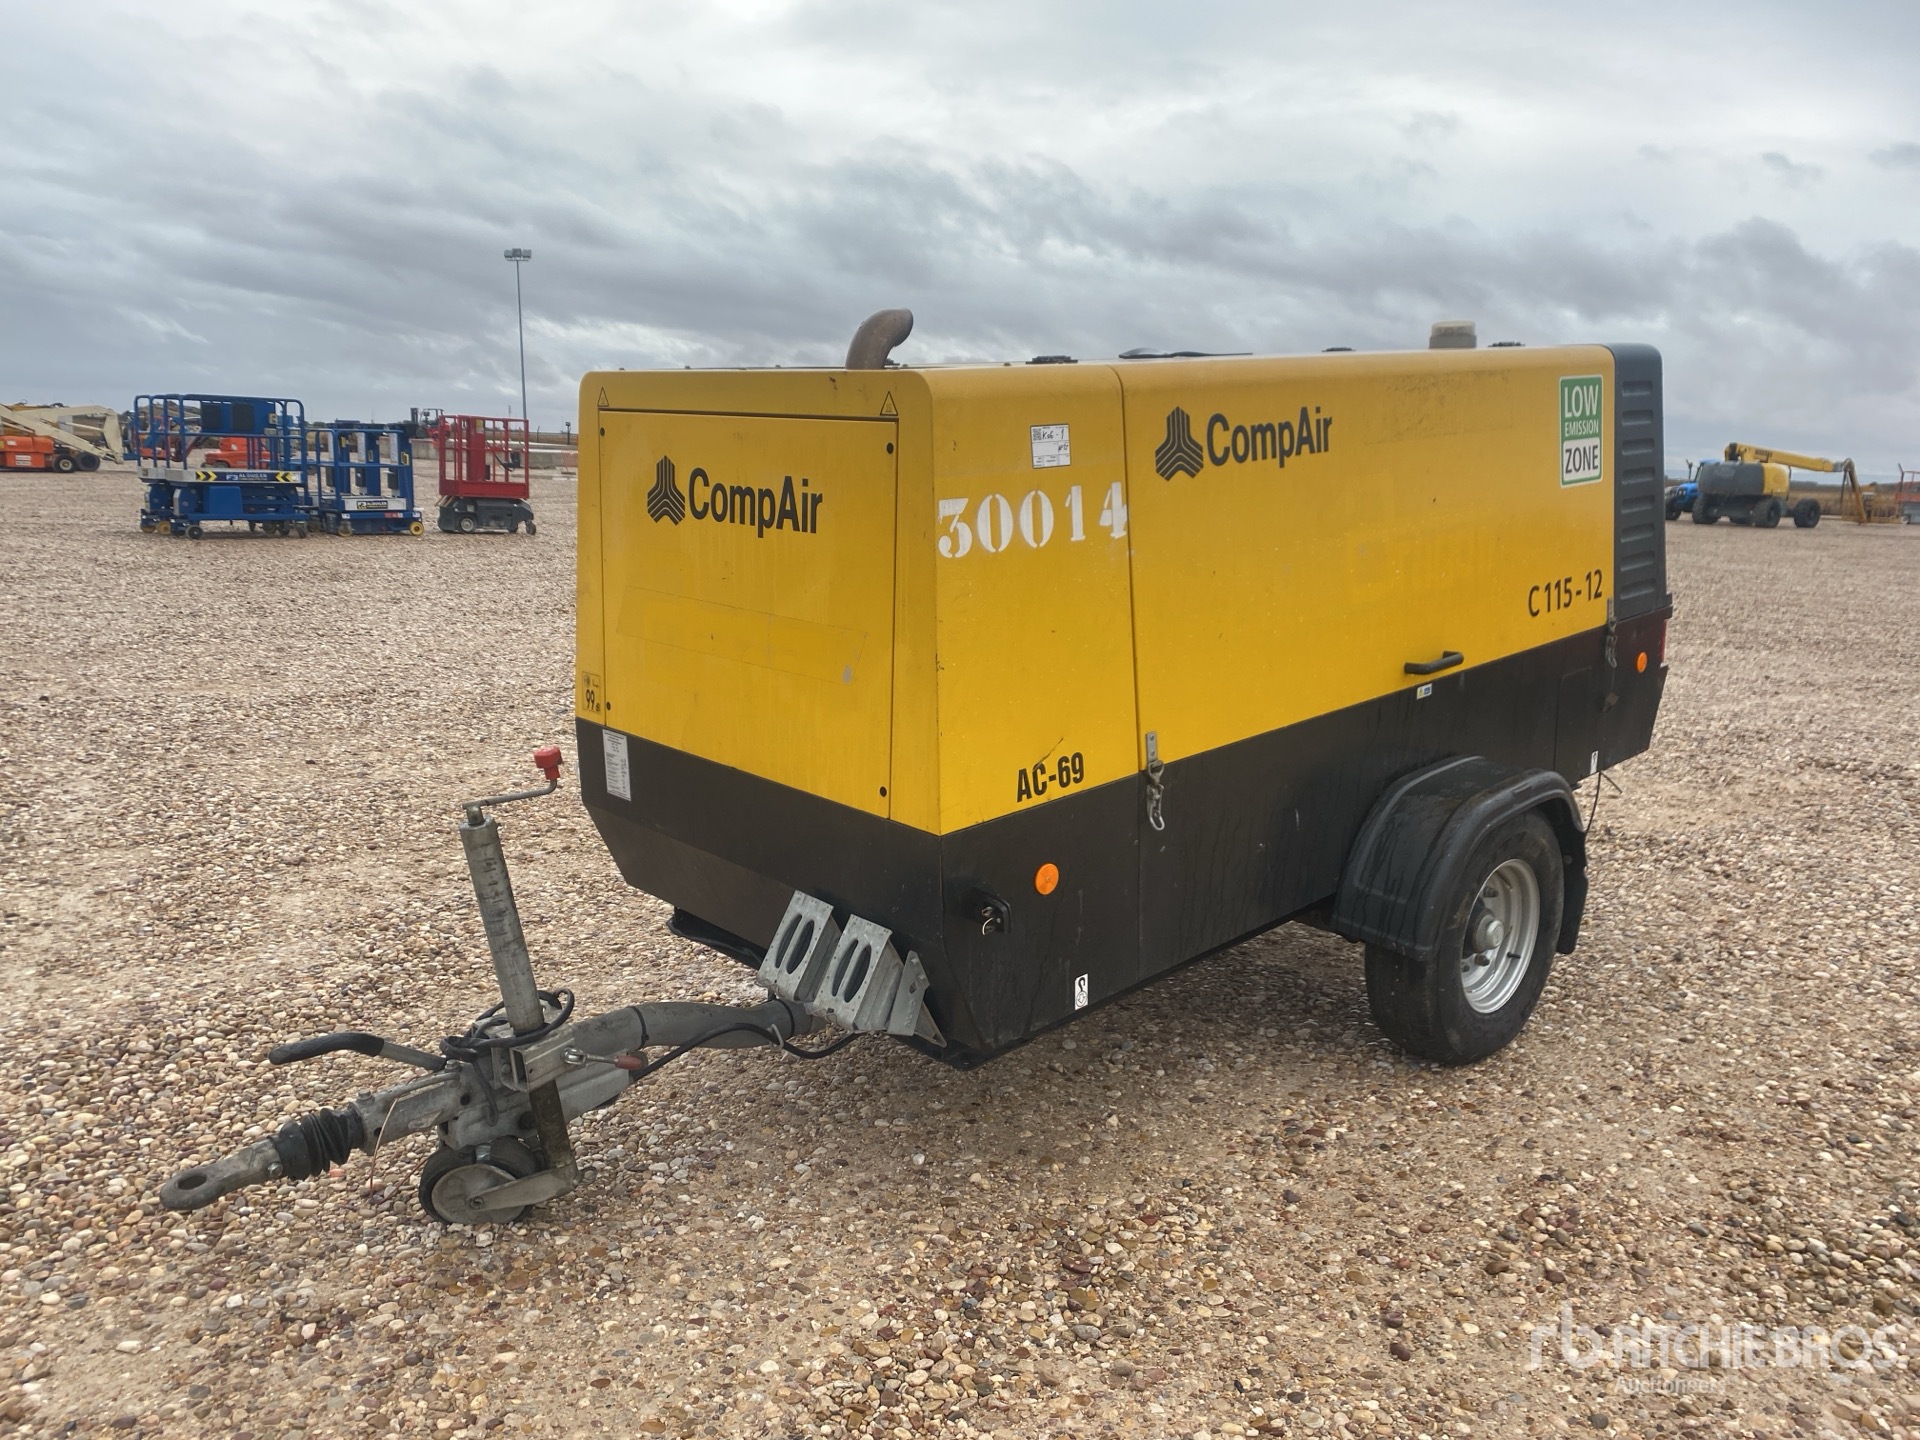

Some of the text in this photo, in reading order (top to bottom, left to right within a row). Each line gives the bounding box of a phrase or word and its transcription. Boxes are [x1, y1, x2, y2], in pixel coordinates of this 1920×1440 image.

[1564, 385, 1599, 418] LOW
[1206, 405, 1333, 469] CompAir
[1565, 419, 1599, 437] EMISSION
[1565, 444, 1599, 474] ZONE
[688, 466, 824, 539] CompAir
[937, 481, 1128, 558] 30014
[586, 689, 594, 710] 99
[1016, 752, 1085, 803] AC-69
